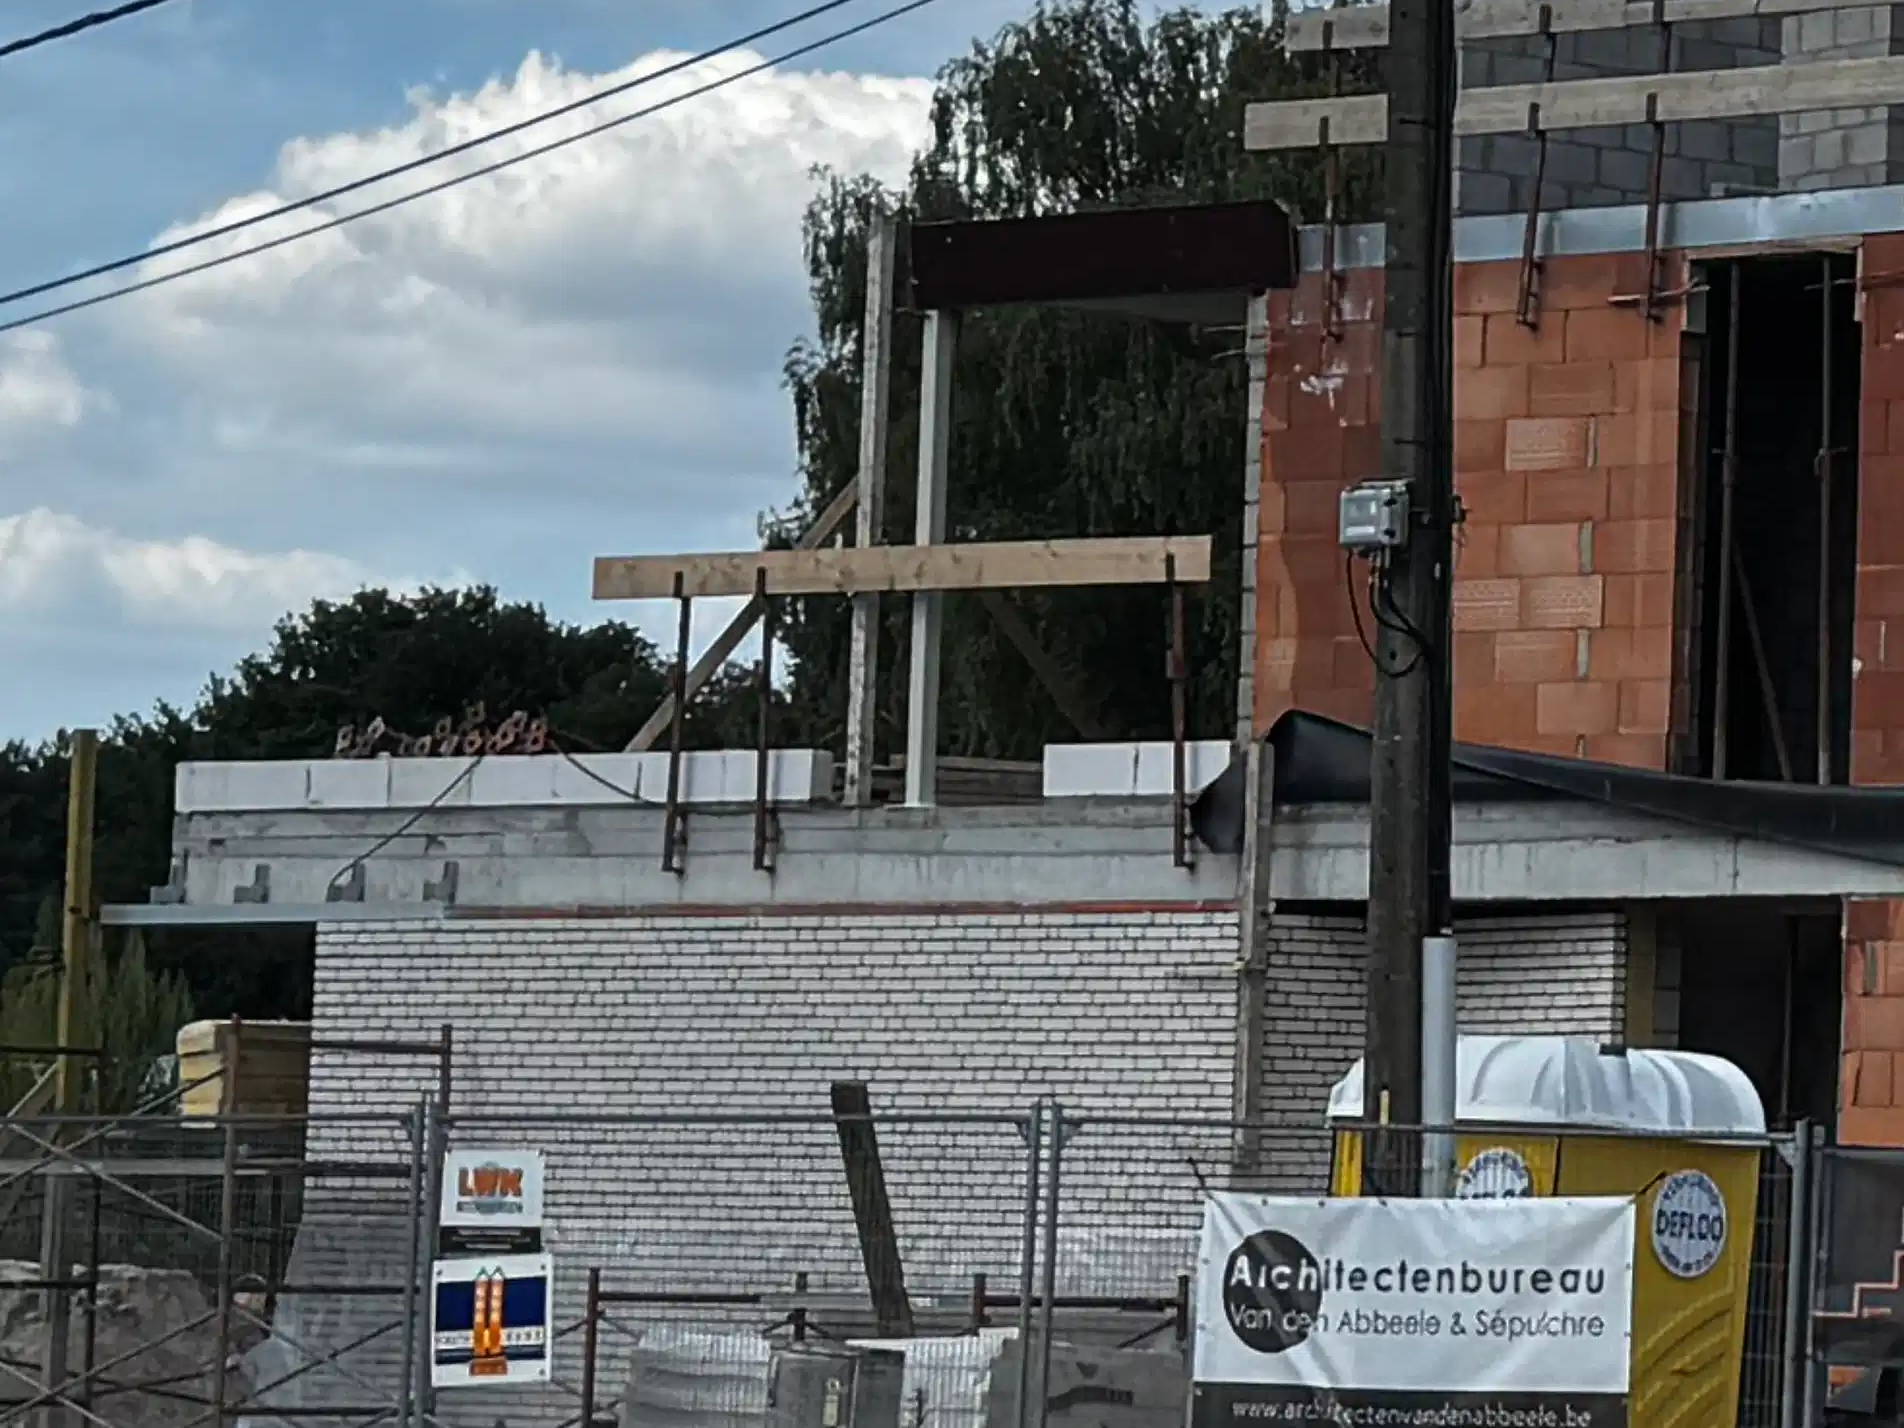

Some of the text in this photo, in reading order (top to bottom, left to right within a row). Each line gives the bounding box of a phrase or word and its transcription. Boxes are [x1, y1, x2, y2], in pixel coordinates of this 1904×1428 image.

[1230, 1255, 1605, 1296] Architectenbureau
[1231, 1305, 1605, 1342] Van den Abbeele & Sépulchre
